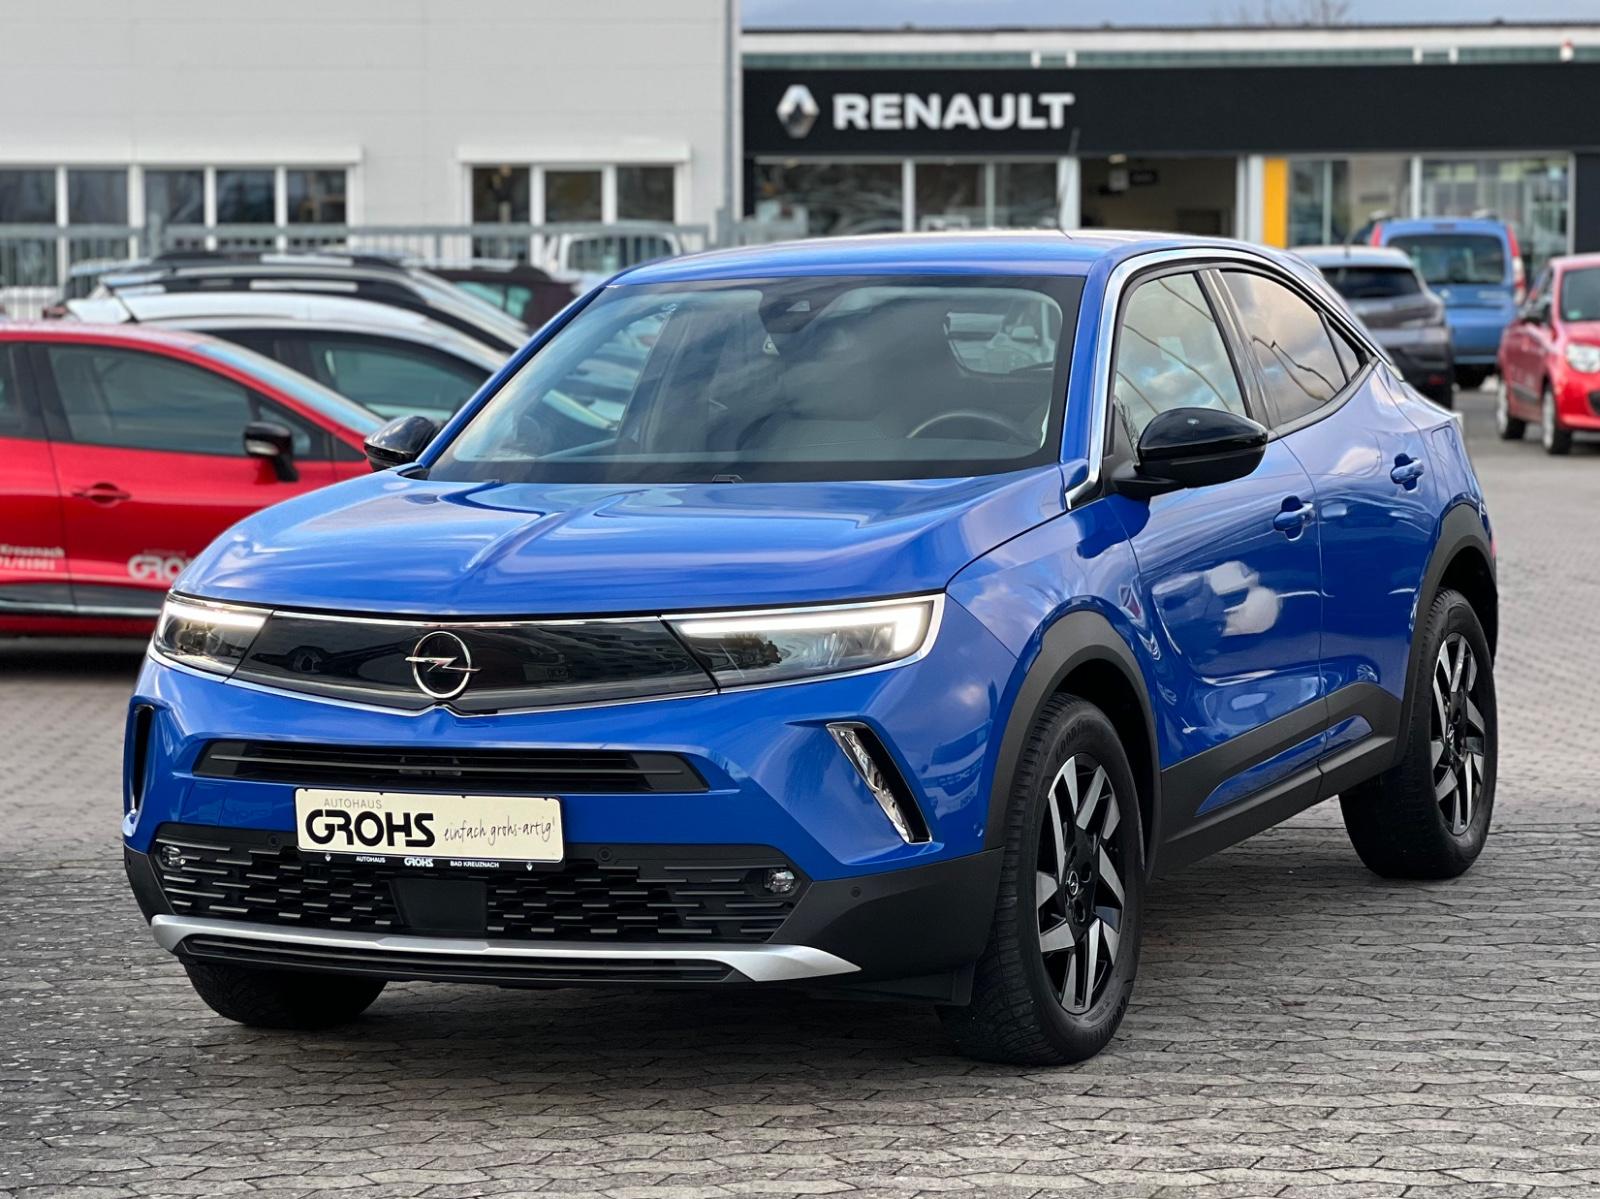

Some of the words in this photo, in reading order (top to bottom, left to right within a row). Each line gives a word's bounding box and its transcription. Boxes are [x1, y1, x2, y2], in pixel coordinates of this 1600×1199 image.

[832, 93, 1076, 130] RENAULT
[127, 554, 193, 580] GRO
[323, 798, 383, 810] AUTOHAUS
[305, 809, 436, 848] GROHS
[444, 819, 487, 843] einfach
[487, 815, 556, 847] grohs-artig!
[355, 856, 386, 864] AUTOHAUS
[404, 857, 434, 868] GROHS
[463, 861, 500, 869] KREUZNACH
